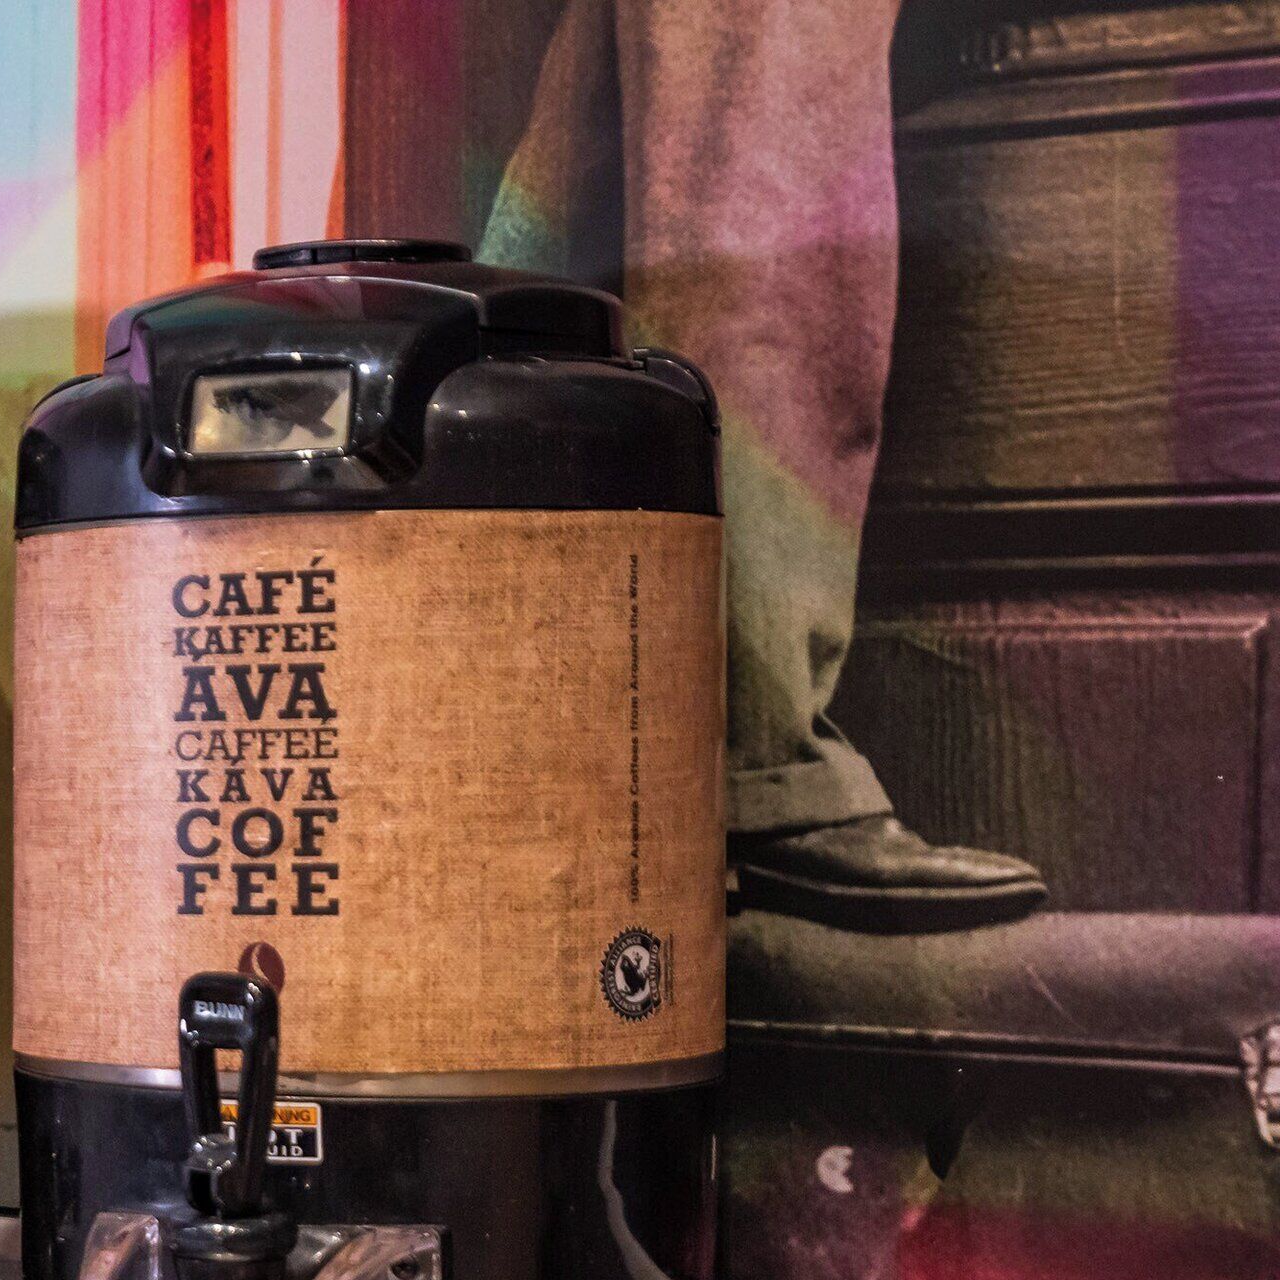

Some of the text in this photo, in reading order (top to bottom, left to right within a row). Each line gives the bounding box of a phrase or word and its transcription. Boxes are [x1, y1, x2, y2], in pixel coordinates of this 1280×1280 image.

[172, 556, 336, 618] CAFÉ
[629, 554, 639, 599] World
[173, 622, 337, 657] KAFFEE
[630, 605, 639, 629] the
[630, 634, 639, 691] Around
[630, 695, 639, 731] from
[630, 736, 639, 796] Coffees
[176, 807, 339, 858] COF
[176, 863, 339, 916] FEE
[195, 1000, 246, 1021] BUNN
